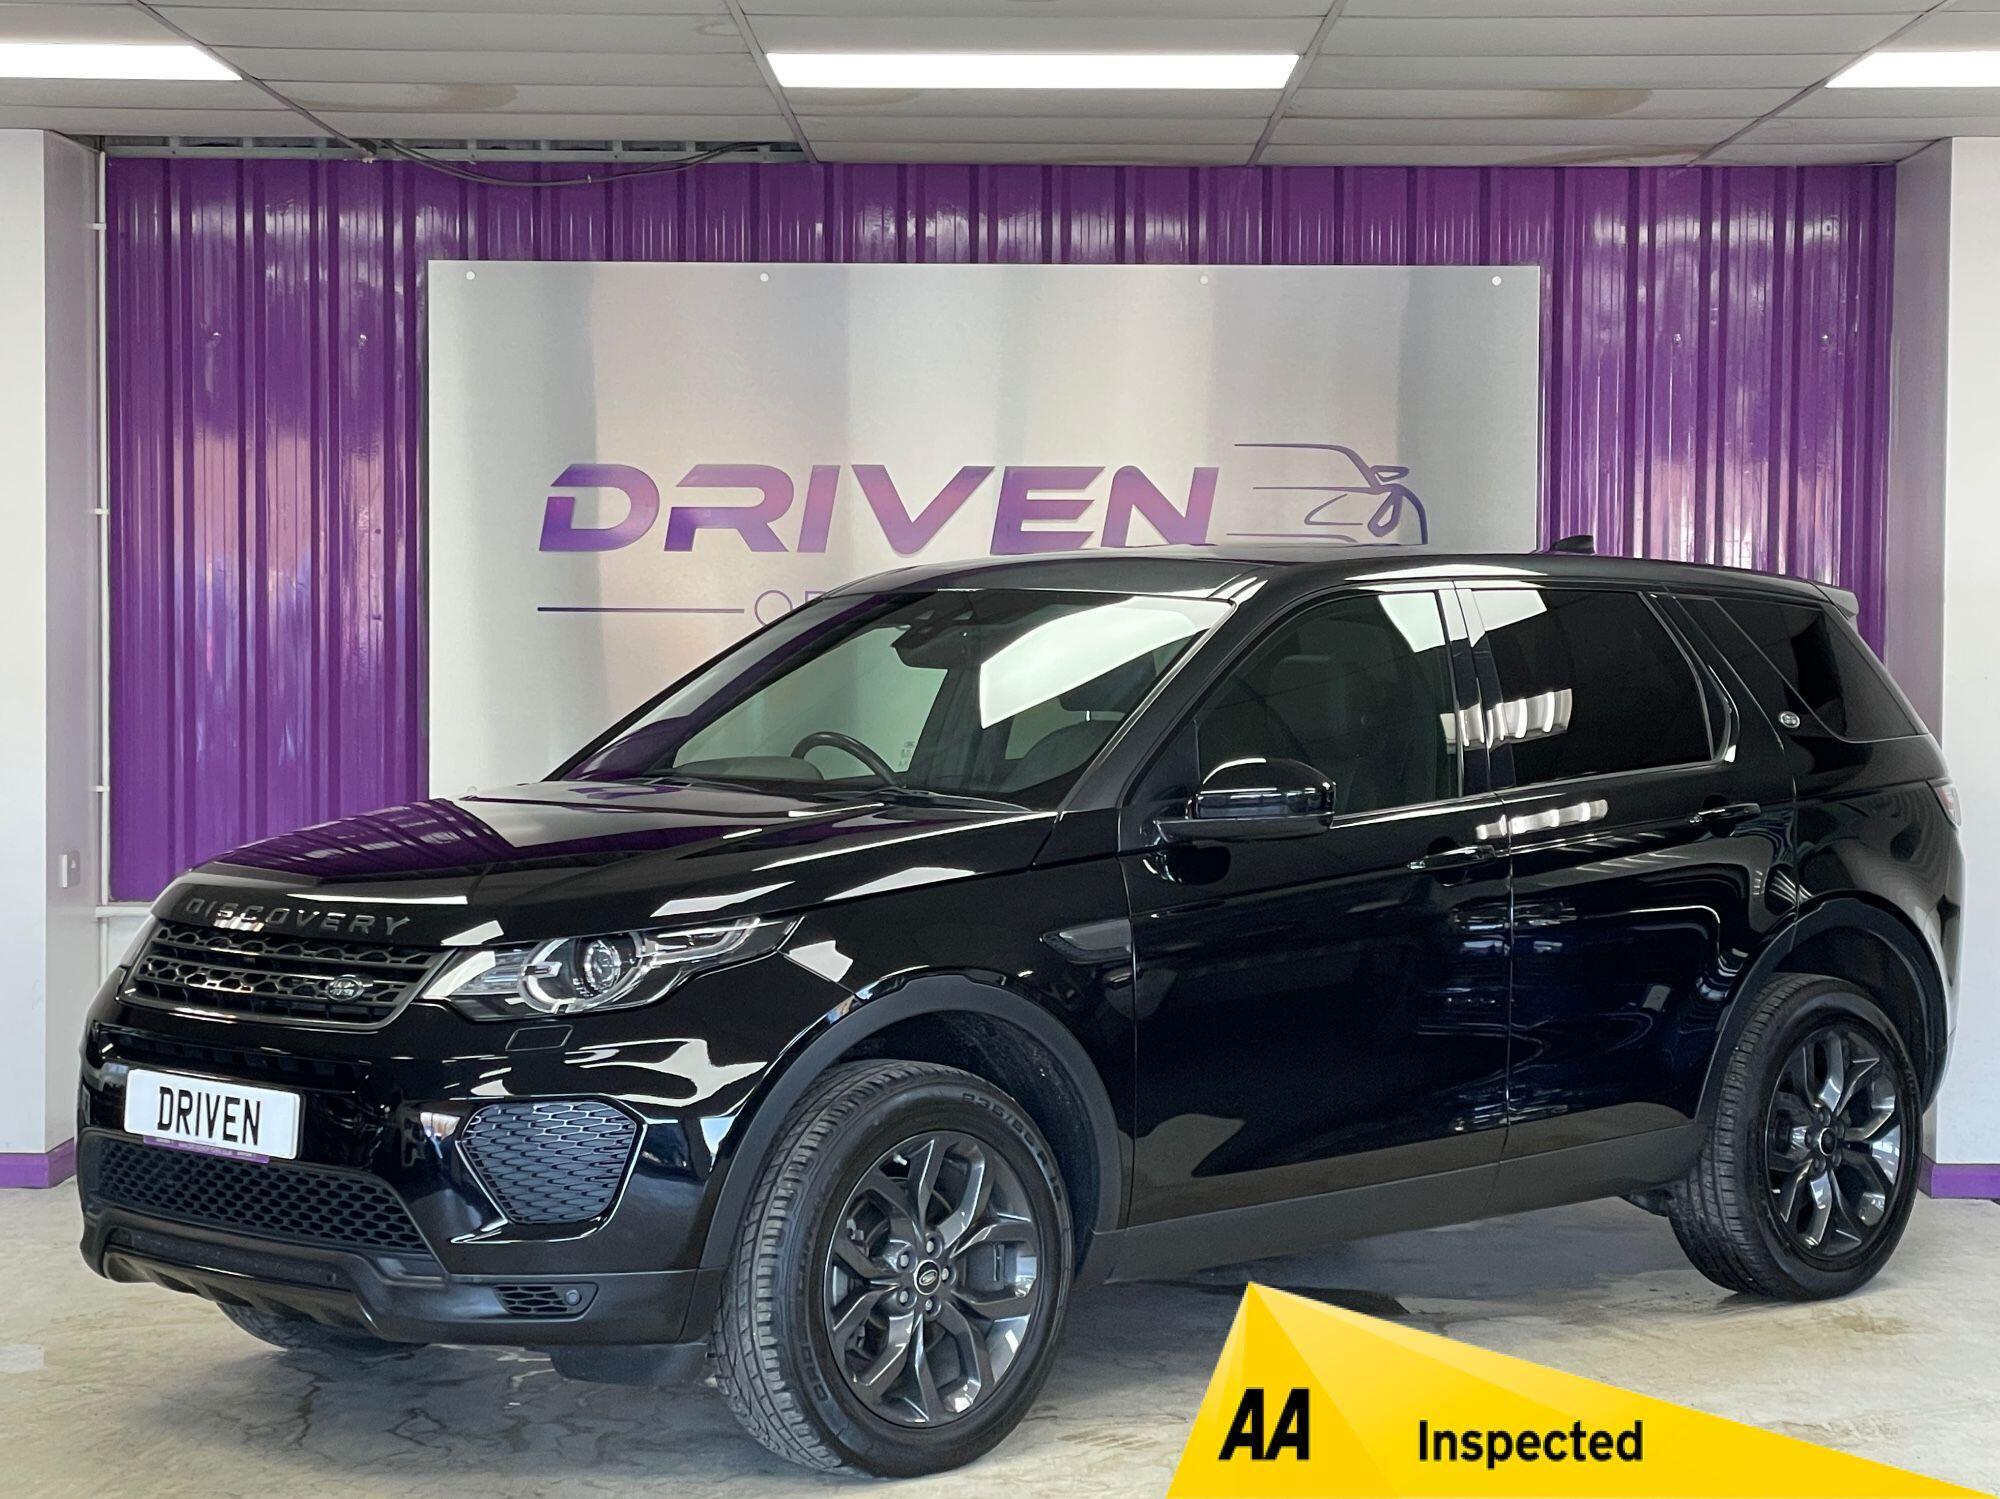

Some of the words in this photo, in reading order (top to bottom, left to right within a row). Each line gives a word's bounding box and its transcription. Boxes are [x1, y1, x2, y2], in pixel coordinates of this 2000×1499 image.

[539, 463, 1219, 556] DRIVEN
[185, 898, 411, 936] DISCOVERY
[156, 1086, 261, 1146] DRIVEN
